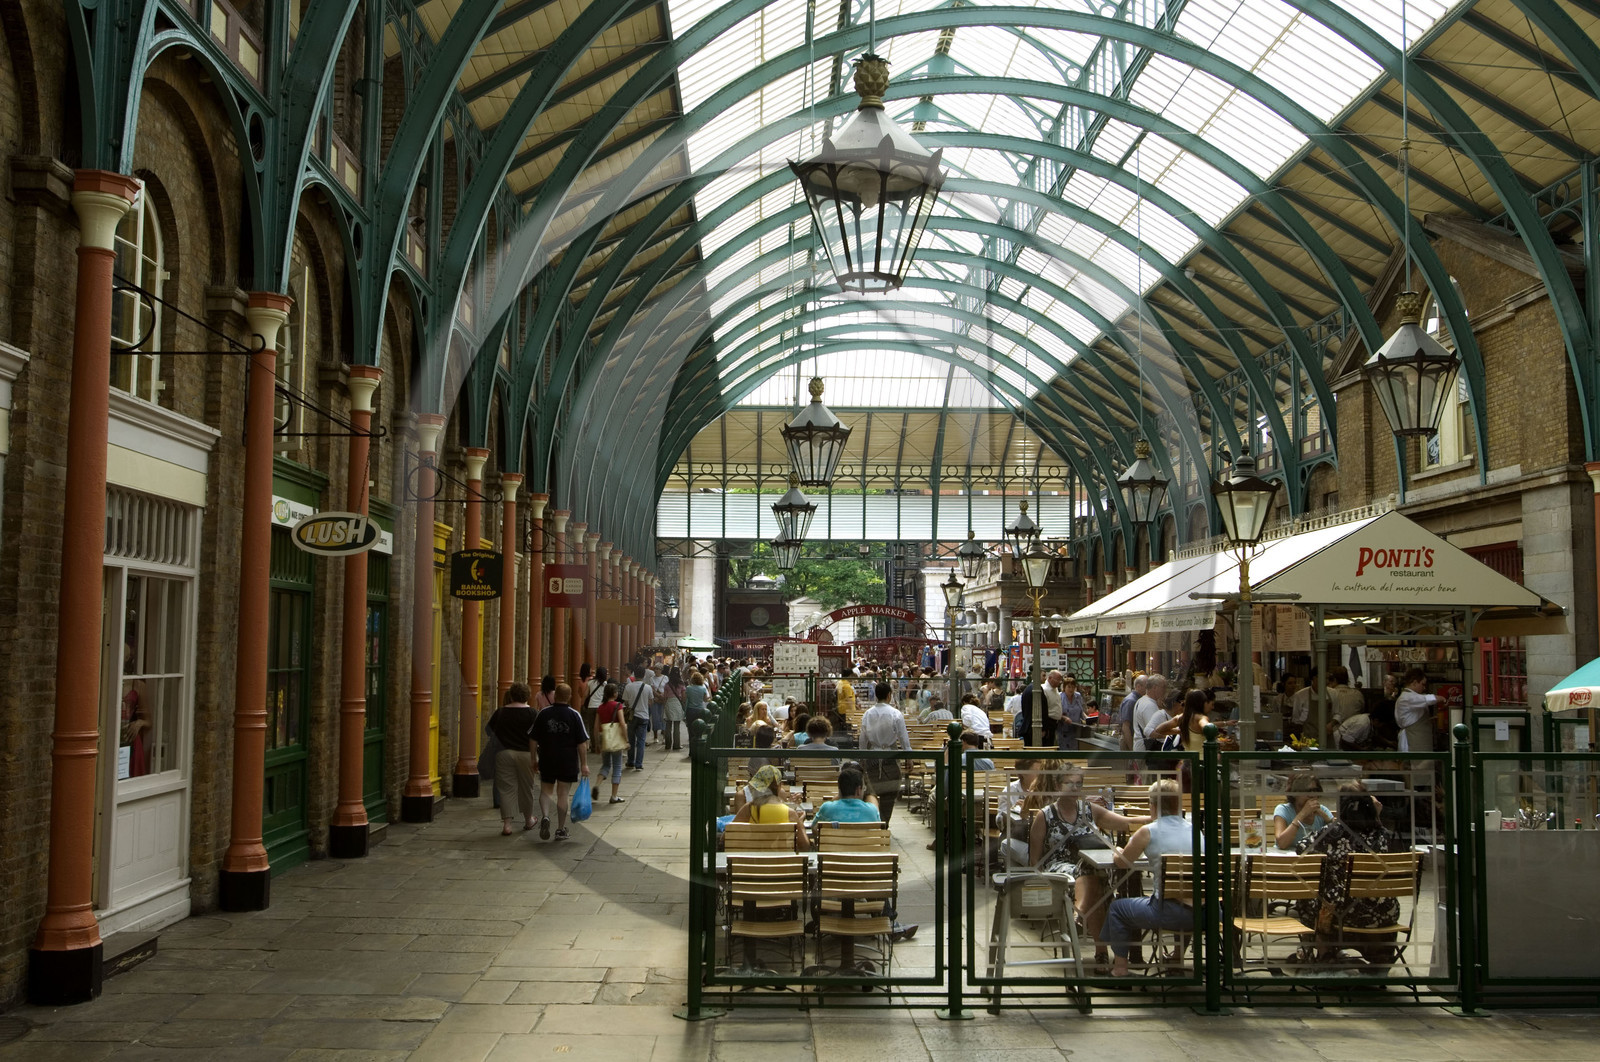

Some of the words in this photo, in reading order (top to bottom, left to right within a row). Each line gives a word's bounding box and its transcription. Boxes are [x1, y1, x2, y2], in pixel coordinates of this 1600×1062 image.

[305, 518, 368, 544] LUSH
[473, 552, 496, 560] Original
[1356, 546, 1434, 577] PONTI'S
[1332, 582, 1341, 592] la
[1344, 582, 1376, 592] cultura
[1380, 582, 1394, 592] del
[1396, 583, 1434, 596] mangiar
[1438, 584, 1456, 592] bene
[841, 606, 866, 618] APPLE
[871, 606, 908, 619] MARKET
